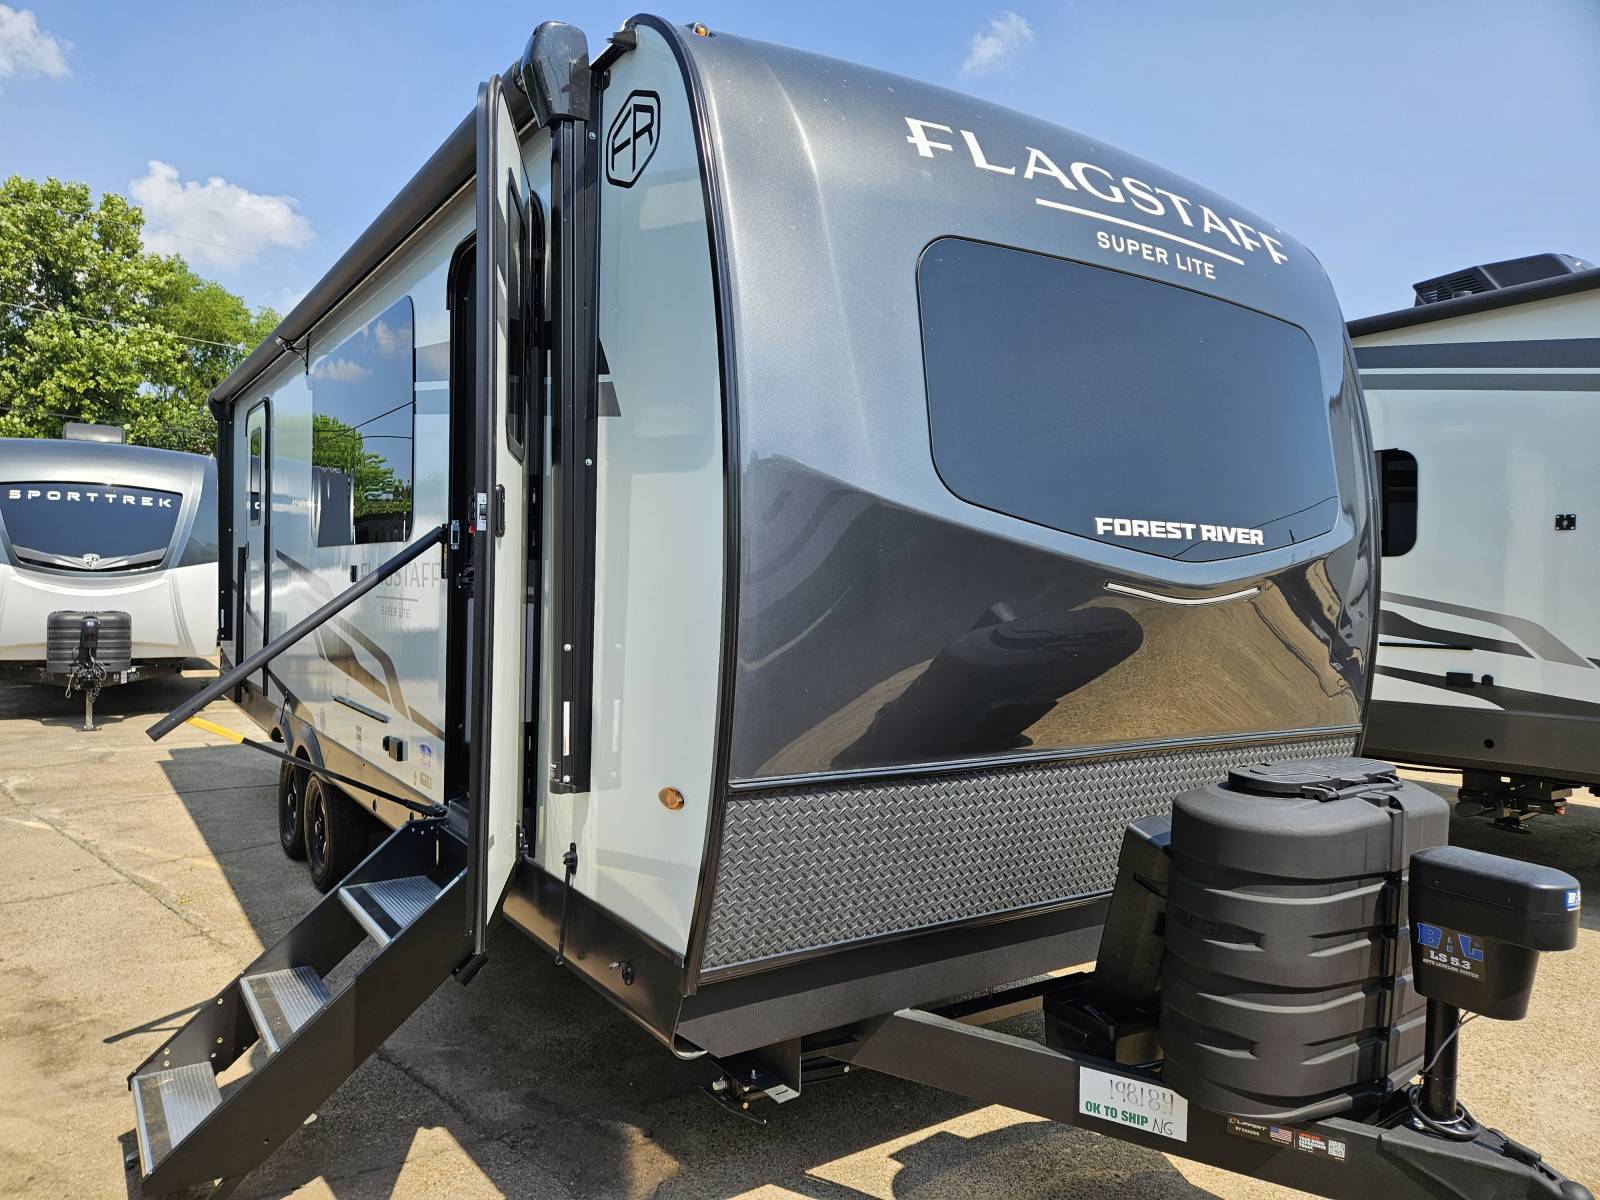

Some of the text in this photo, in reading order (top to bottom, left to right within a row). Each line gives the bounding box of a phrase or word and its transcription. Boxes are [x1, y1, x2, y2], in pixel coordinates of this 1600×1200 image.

[904, 117, 1289, 266] FLAGSTAFF
[1096, 231, 1217, 280] SUPER LITE
[8, 489, 172, 508] SPORTTREK
[1095, 517, 1265, 545] FOREST RIVER
[1430, 950, 1447, 963] LS
[1085, 1101, 1149, 1126] OK TO SHIP
[1152, 1117, 1174, 1136] NG
